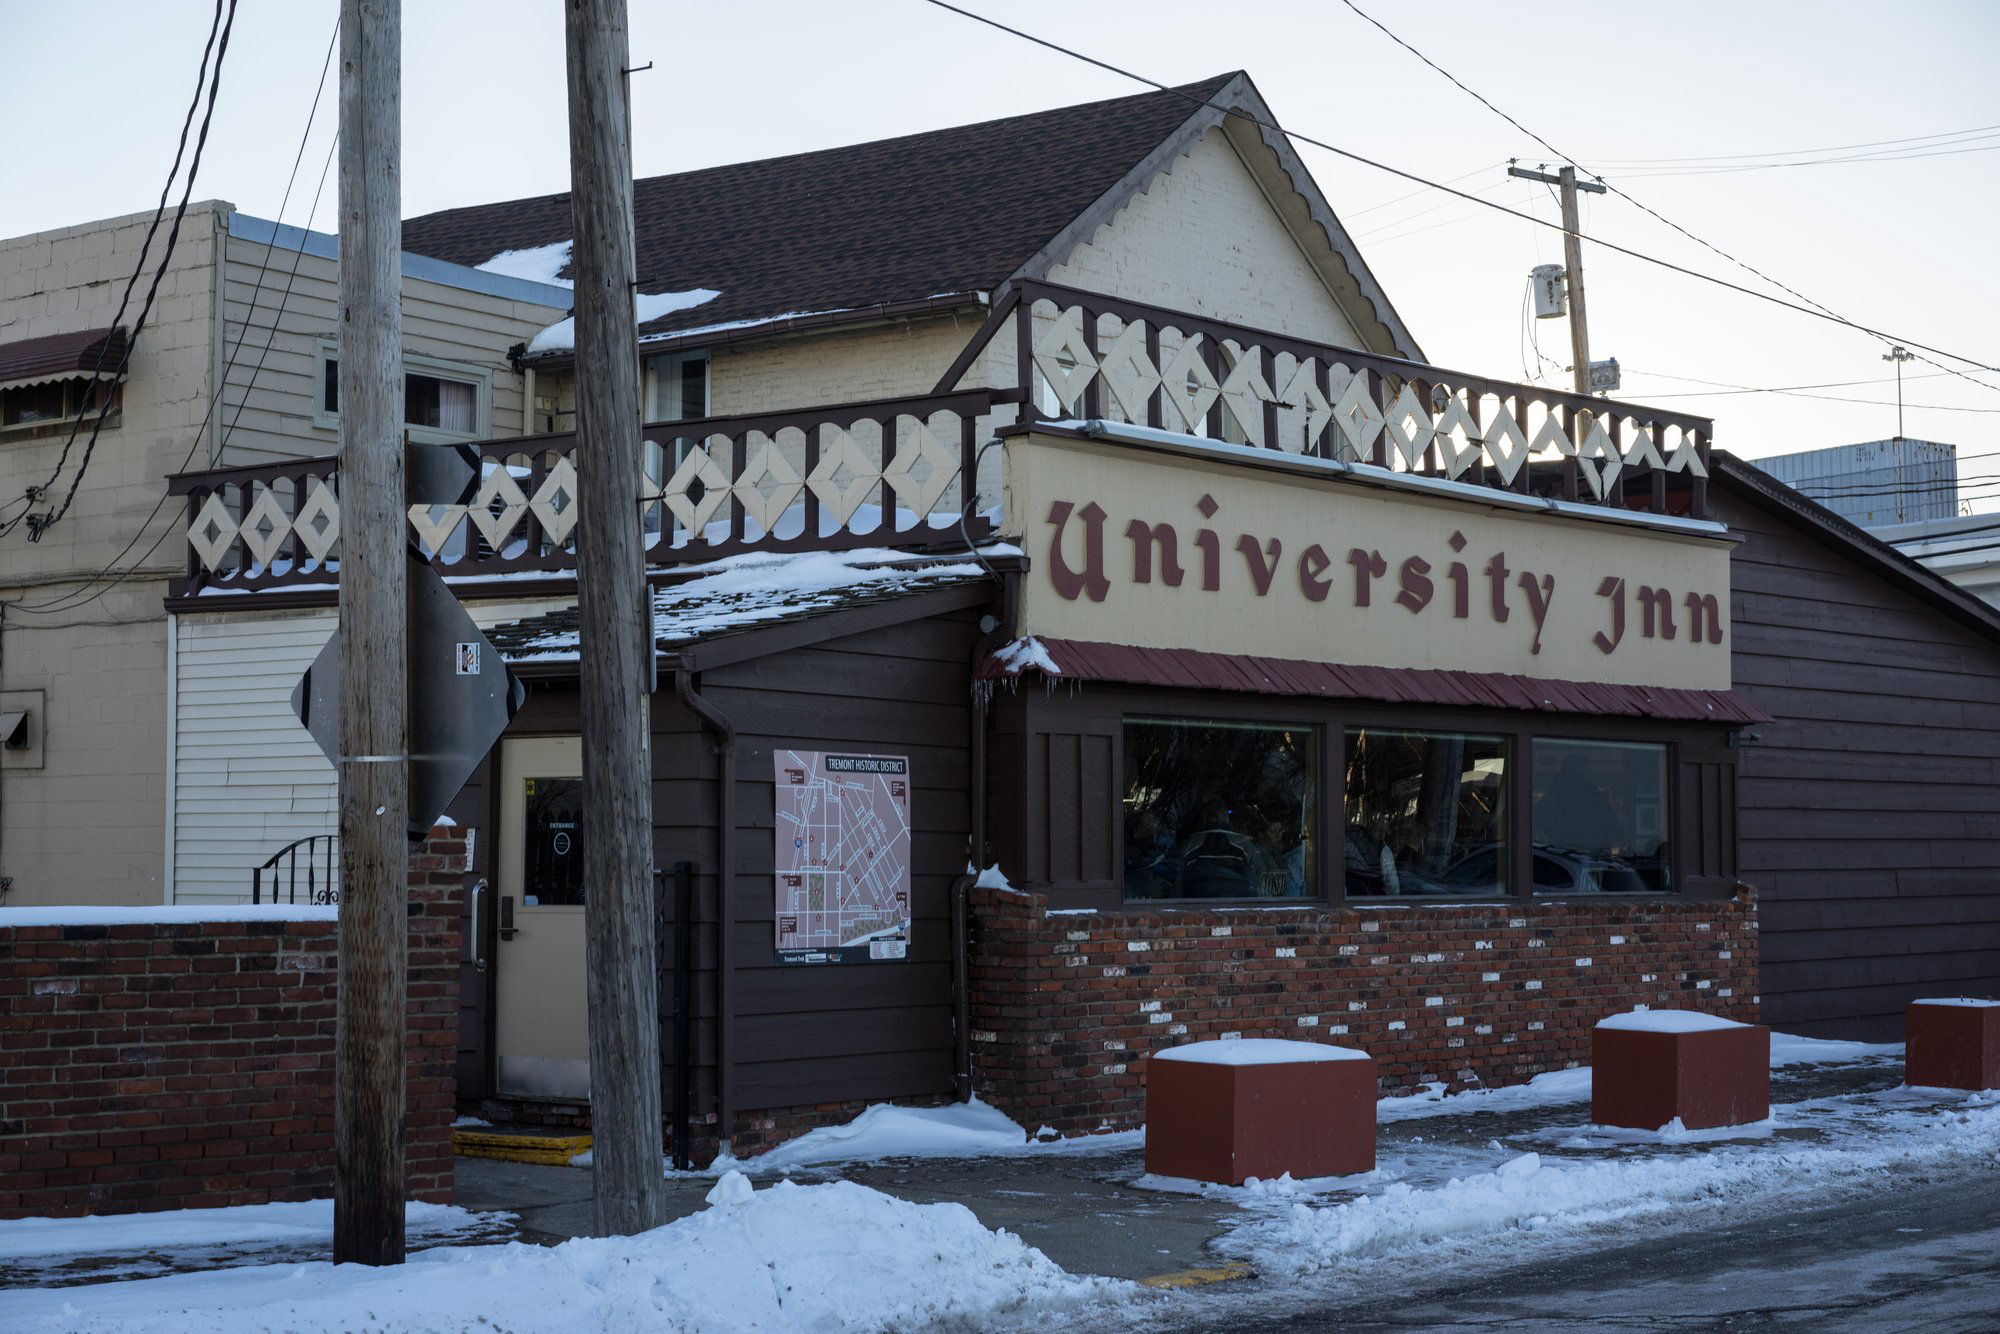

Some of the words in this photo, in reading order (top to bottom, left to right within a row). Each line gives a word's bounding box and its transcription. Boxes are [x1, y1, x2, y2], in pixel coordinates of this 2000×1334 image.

[1046, 493, 1555, 654] University
[1594, 575, 1723, 654] Inn
[828, 758, 855, 770] TREMONT
[856, 760, 880, 771] HISTORIC
[880, 761, 904, 773] DISTRICT
